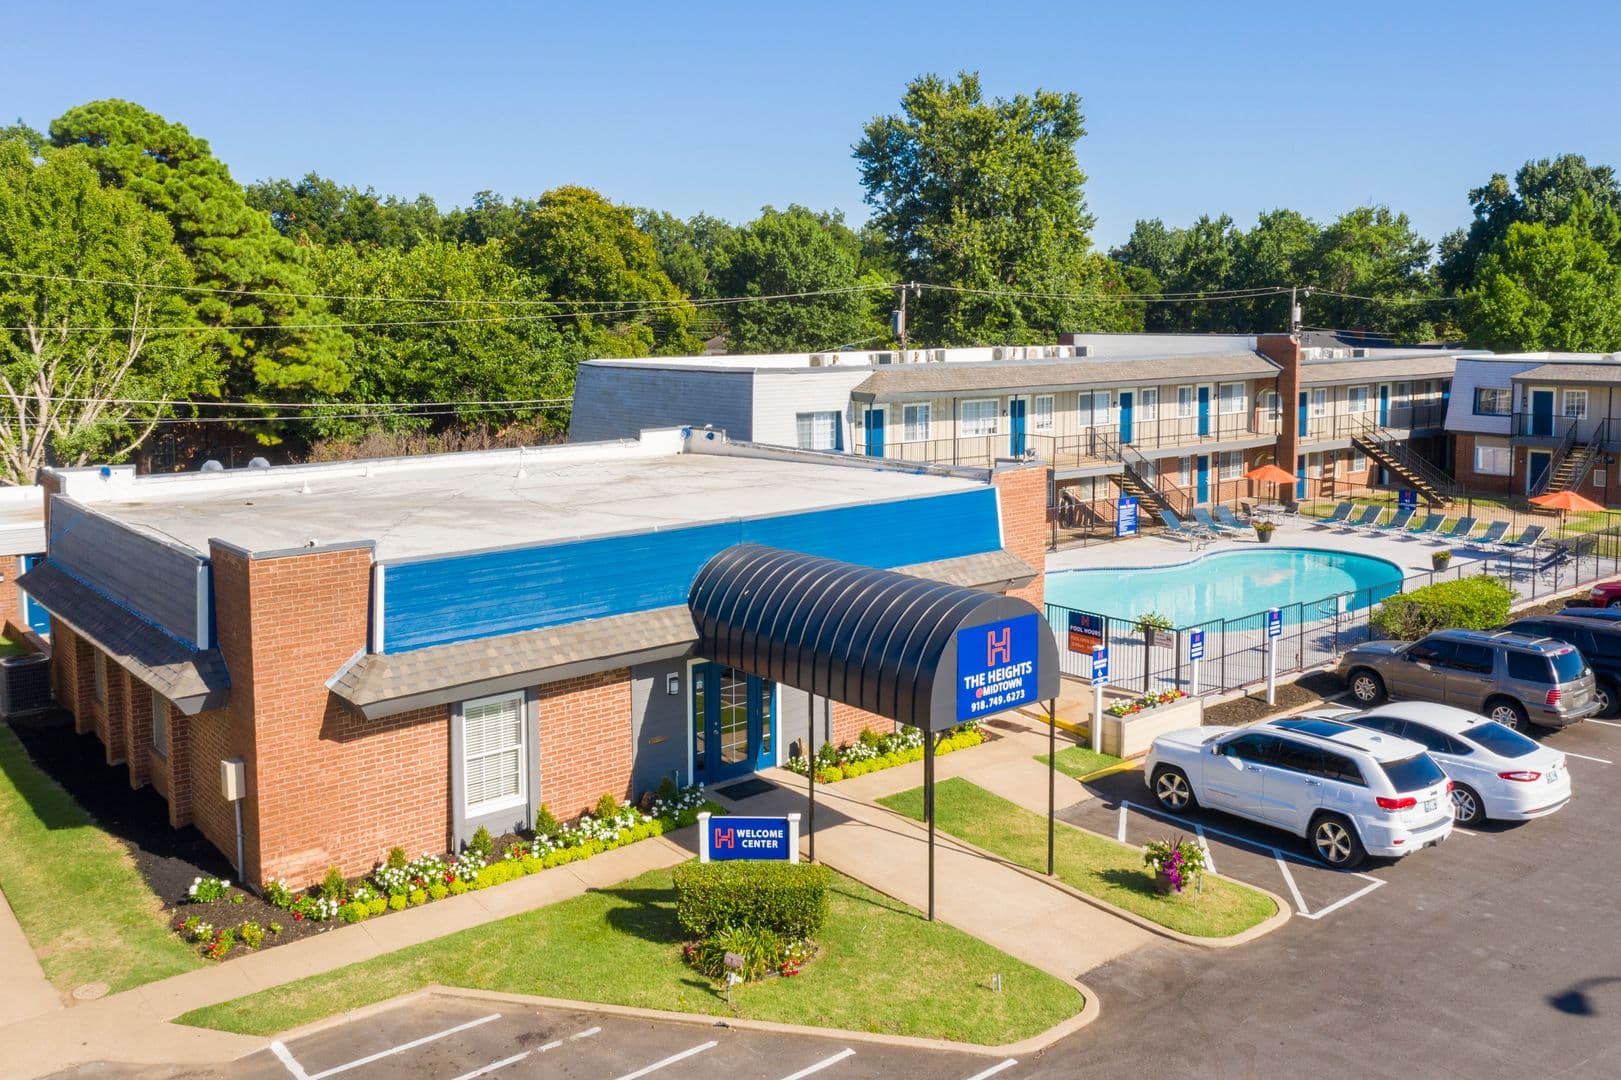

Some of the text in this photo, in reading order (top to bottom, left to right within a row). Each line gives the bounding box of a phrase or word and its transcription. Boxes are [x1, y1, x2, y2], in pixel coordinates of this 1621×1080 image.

[1070, 625, 1083, 634] POOL
[988, 628, 1010, 666] H
[964, 661, 1032, 689] THE HEIGHTS
[971, 689, 1025, 712] 918.749.6273
[715, 828, 783, 848] H WELCOME
[742, 839, 778, 848] CENTER
